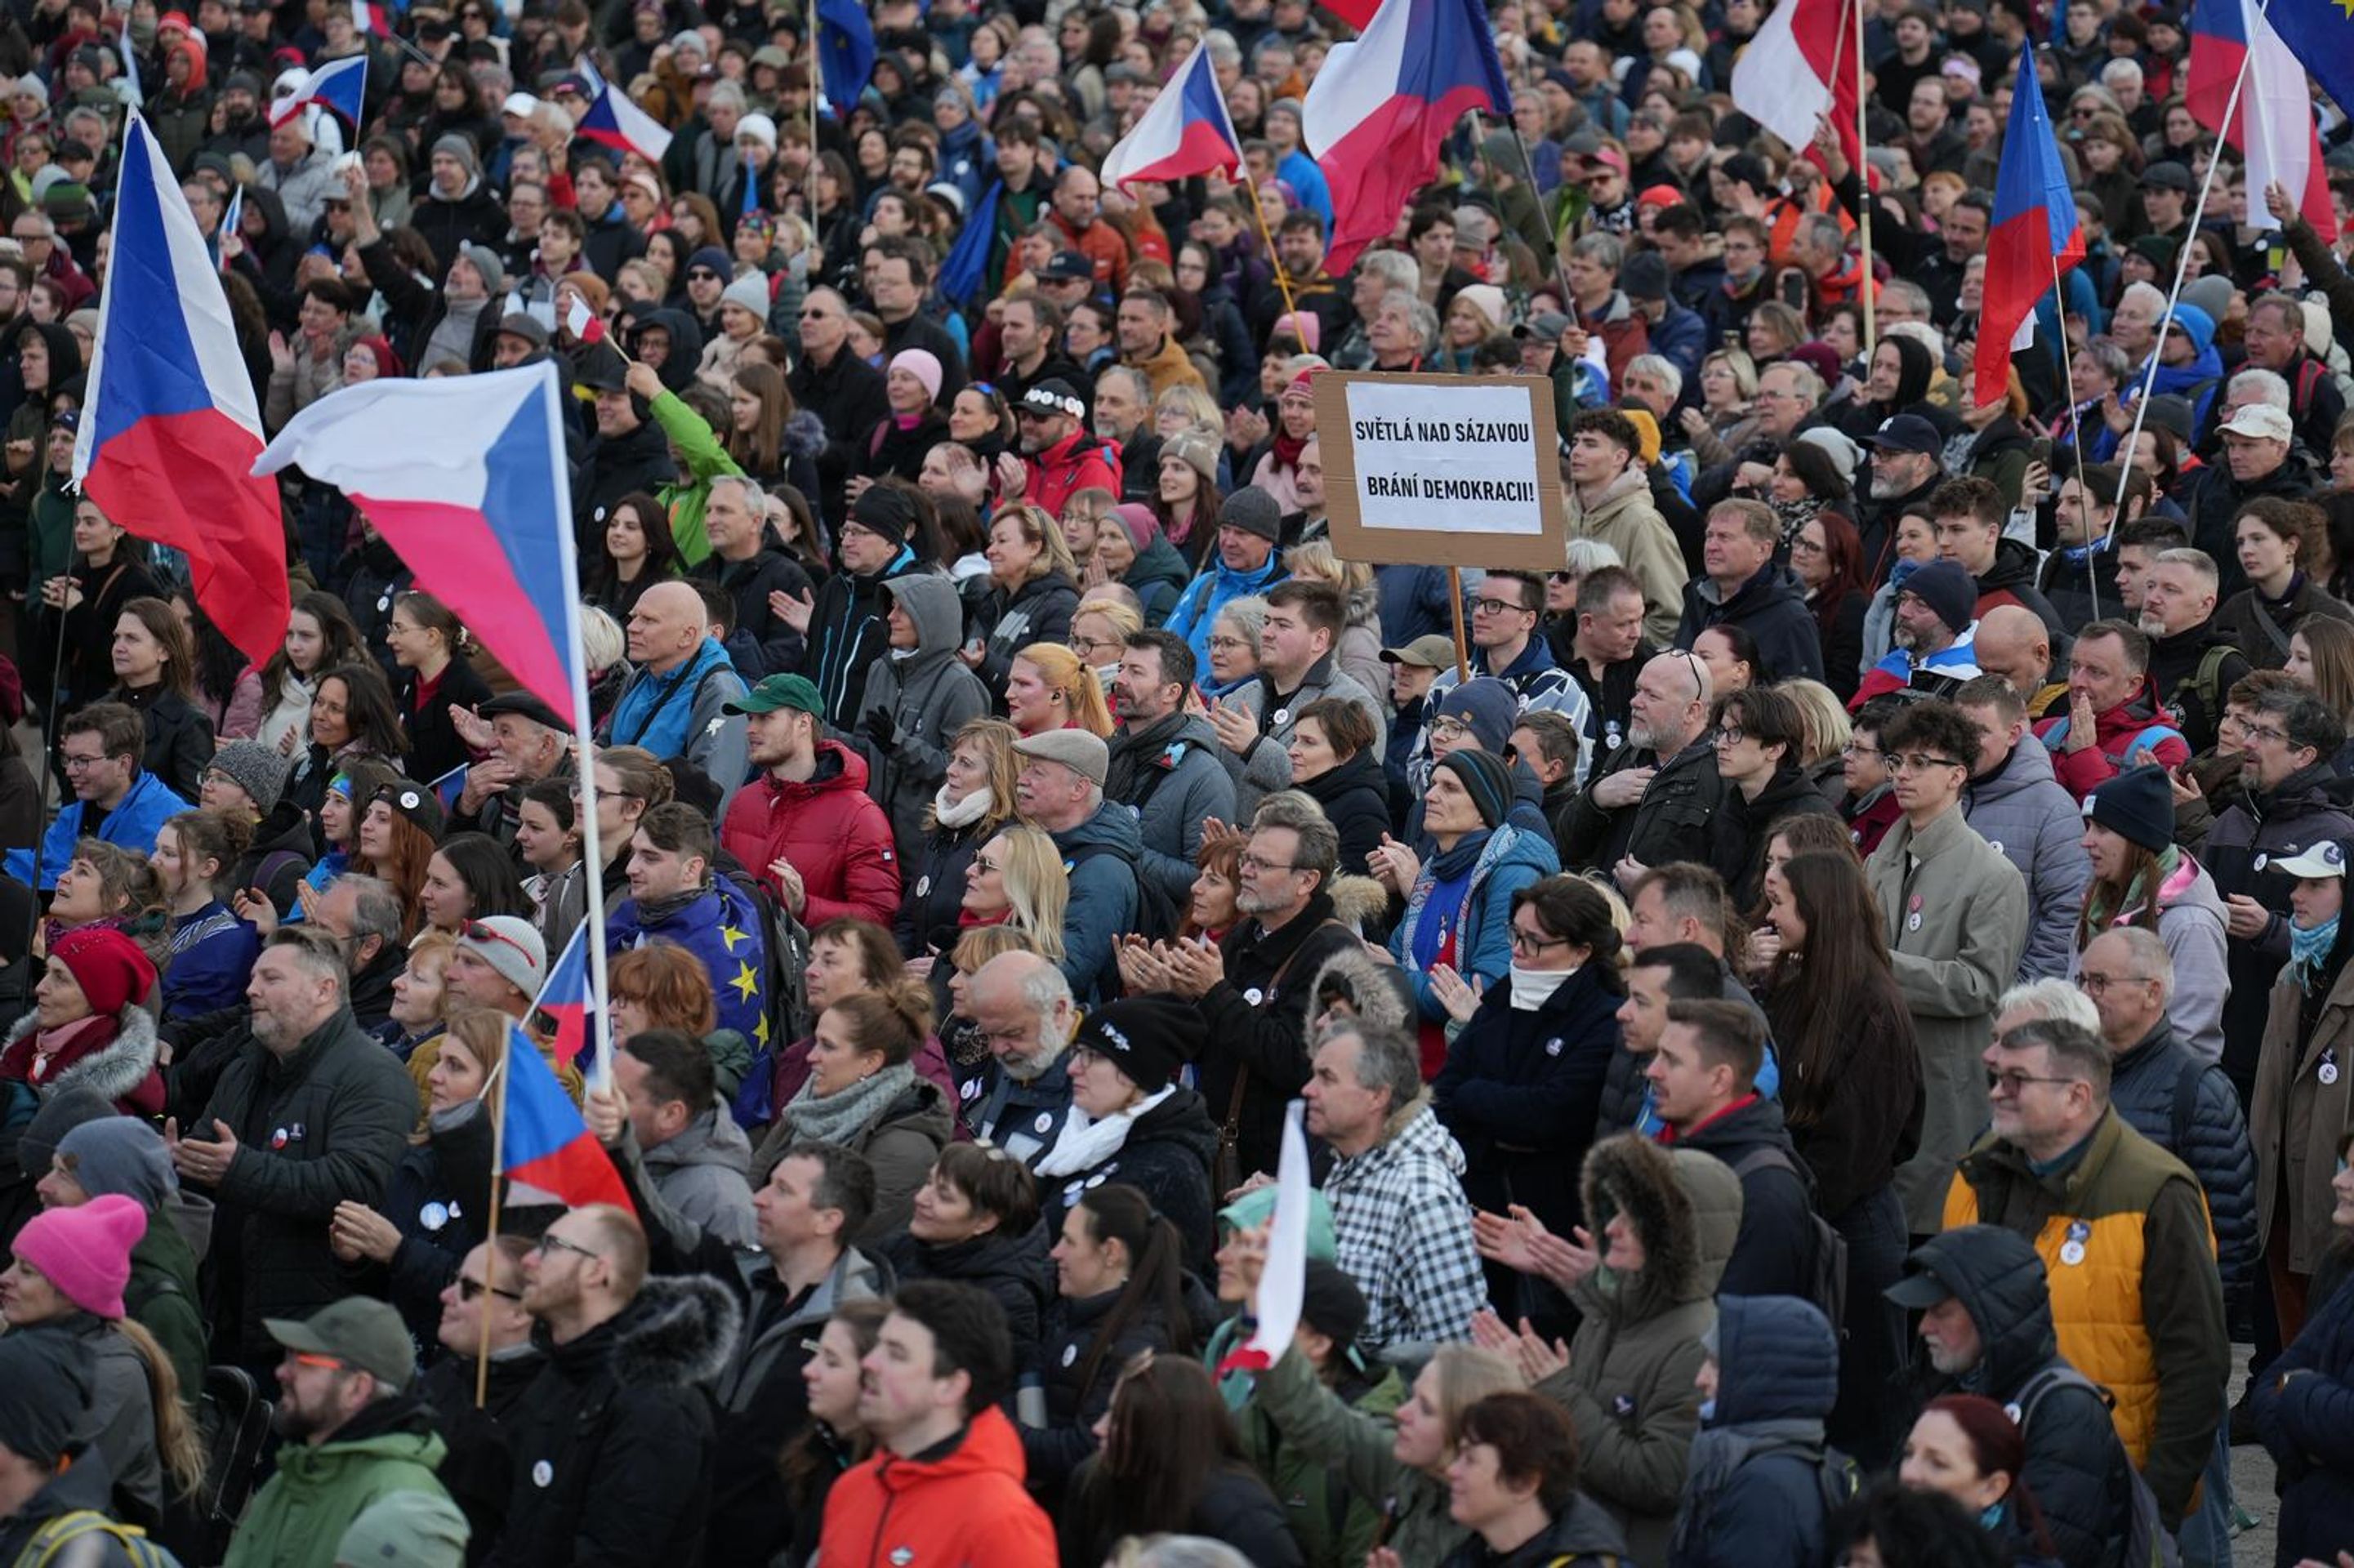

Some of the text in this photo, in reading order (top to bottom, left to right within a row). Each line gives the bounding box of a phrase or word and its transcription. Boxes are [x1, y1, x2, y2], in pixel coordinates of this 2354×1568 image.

[1355, 416, 1529, 443] SVĚTLÁ NAD SÁZAVOU
[1367, 472, 1534, 501] BRÁNÍ DEMOKRACII!
